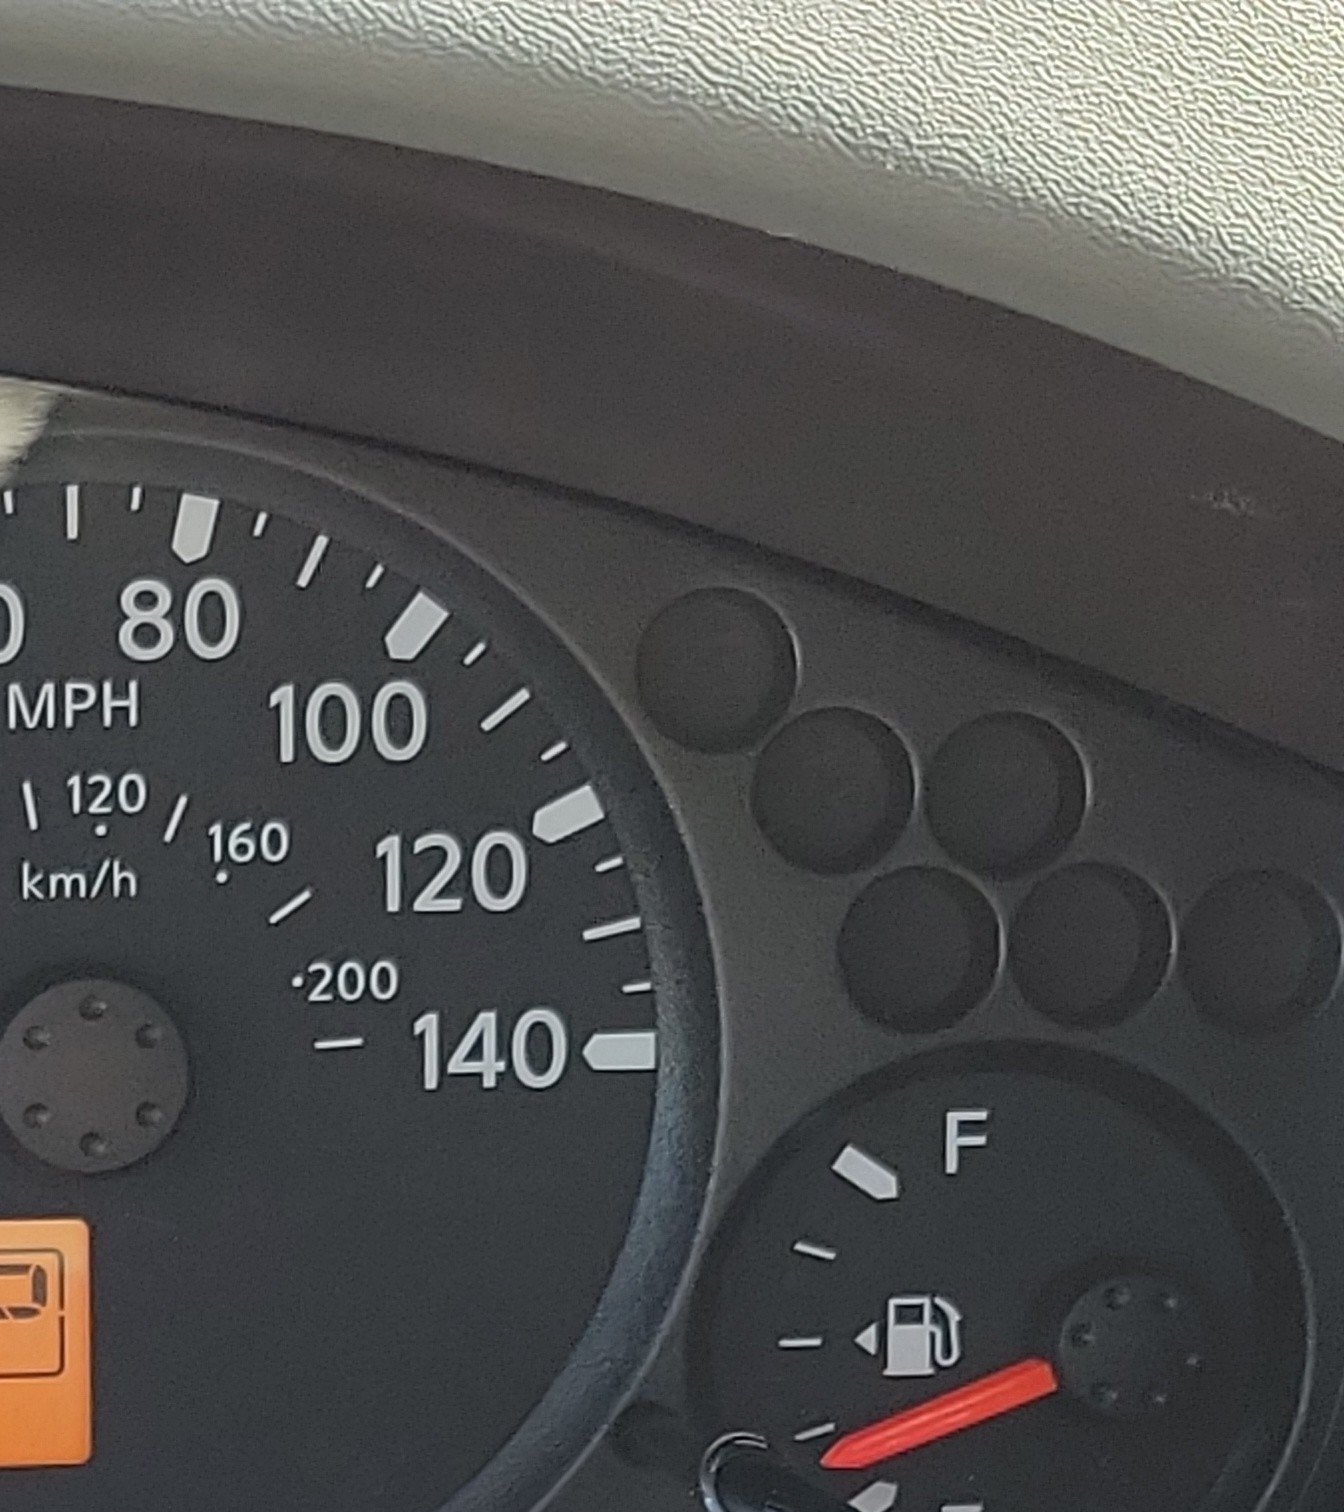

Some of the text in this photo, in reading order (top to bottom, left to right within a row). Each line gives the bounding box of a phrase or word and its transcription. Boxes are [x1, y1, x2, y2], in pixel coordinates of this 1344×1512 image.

[118, 578, 241, 661] 80
[6, 680, 140, 729] MPH
[269, 681, 427, 762] 100
[66, 773, 147, 814] 120
[208, 822, 289, 863] 160
[375, 830, 527, 912] 120
[22, 859, 138, 900] km/h
[307, 960, 398, 1001] 200
[413, 1008, 566, 1090] 140
[944, 1109, 989, 1175] F
